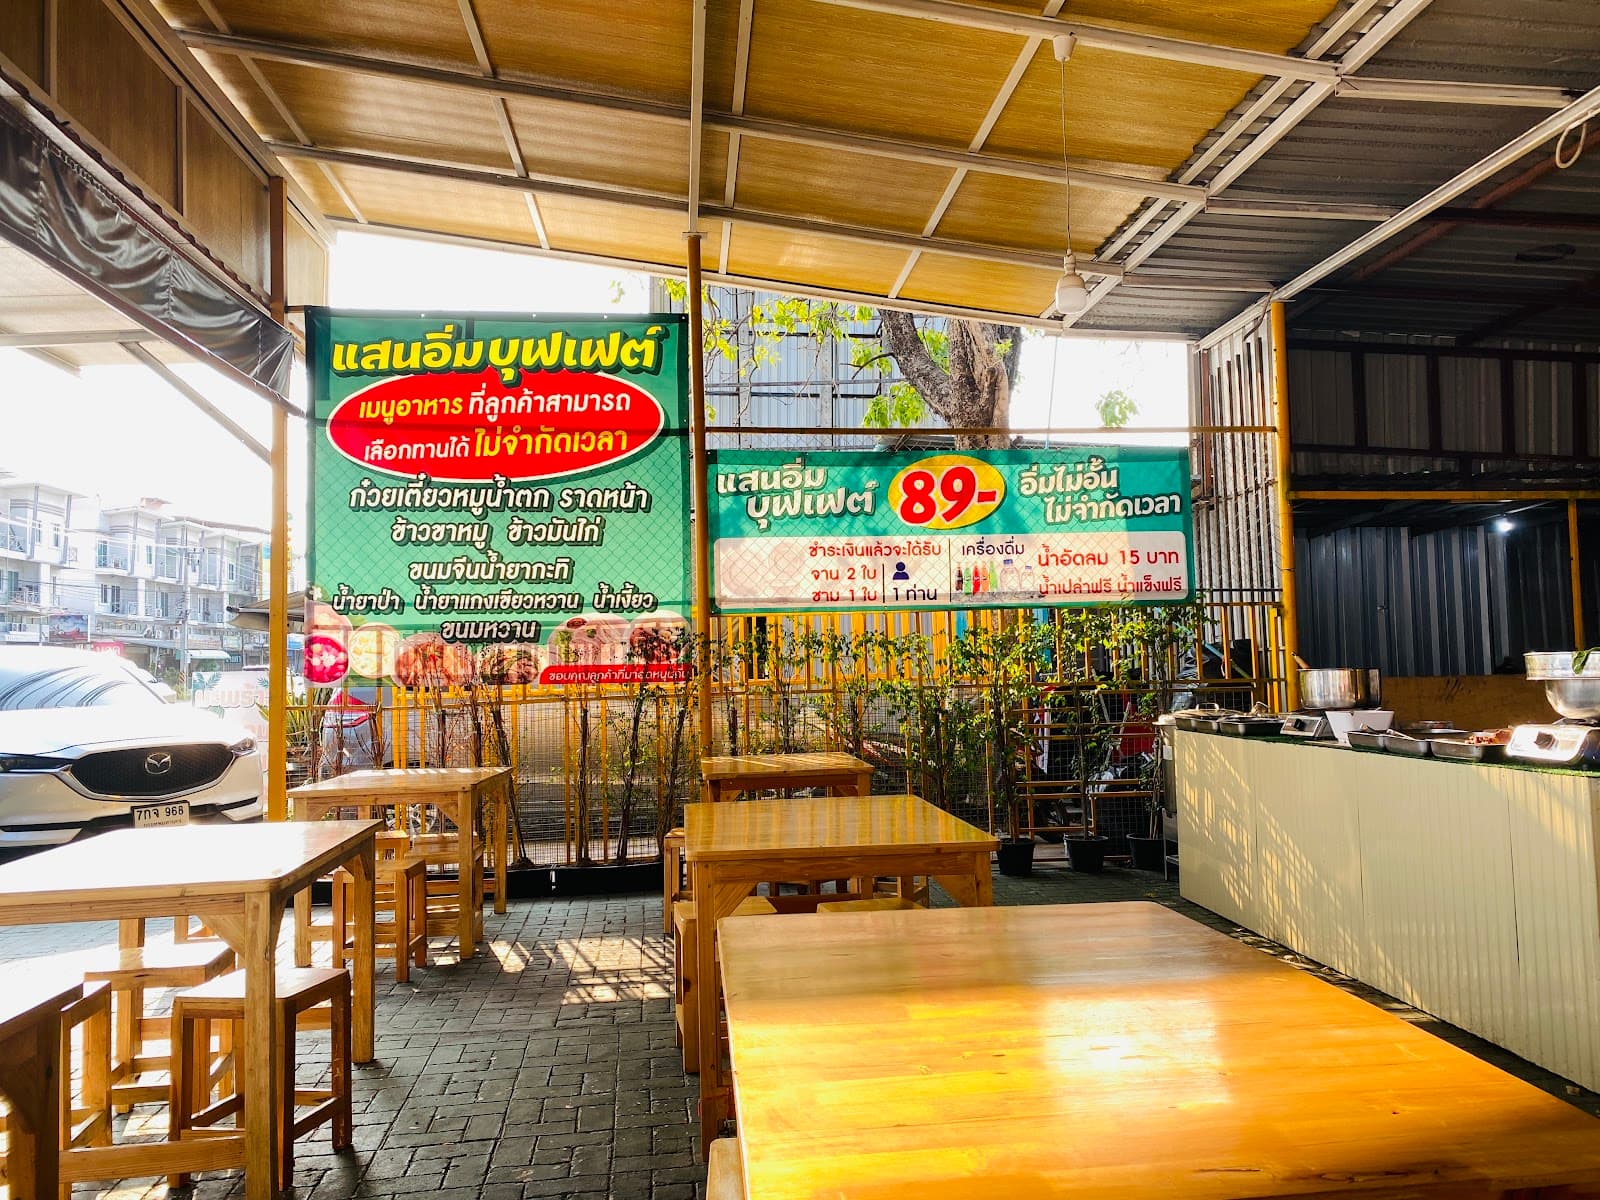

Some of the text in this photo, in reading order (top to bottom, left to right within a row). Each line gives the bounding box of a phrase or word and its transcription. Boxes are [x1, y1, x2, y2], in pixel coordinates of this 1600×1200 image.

[359, 384, 631, 425] เมนูอาหาร ที่ลูกค้าสามารถ
[364, 428, 628, 461] เลือกทานได้ ไม่จำกัดเวลา
[717, 457, 826, 494] แสนอิ่ม
[1020, 457, 1118, 495] อิ่มไม่อั้น
[559, 482, 648, 509] ราดหน้า
[747, 481, 880, 529] บุฟเฟต์
[1045, 493, 1181, 523] ไม่จำกัดเวลา
[392, 517, 601, 549] ข้าวขาหมู ข้าวมันไก่
[962, 537, 1025, 555] เครื่องดื่ม
[809, 541, 941, 557] ชำระเงินแล้วจะได้รับ
[1038, 544, 1179, 566] น้ำอัดลม 15 บาท
[409, 551, 570, 581] ขนมจีนน้ำยากะทิ
[811, 566, 876, 580] จาน 2 ใบ
[812, 587, 877, 602] ชาม 1 ใบ
[893, 585, 937, 600] 1 ท่าน
[1117, 574, 1182, 593] น้ำแข็งฟรี
[332, 584, 401, 611] น้ำยาป่า
[415, 586, 579, 610] น้ำยาแกงเขียวหวาน
[442, 620, 537, 641] ขนมหวาน
[165, 805, 184, 817] 968
